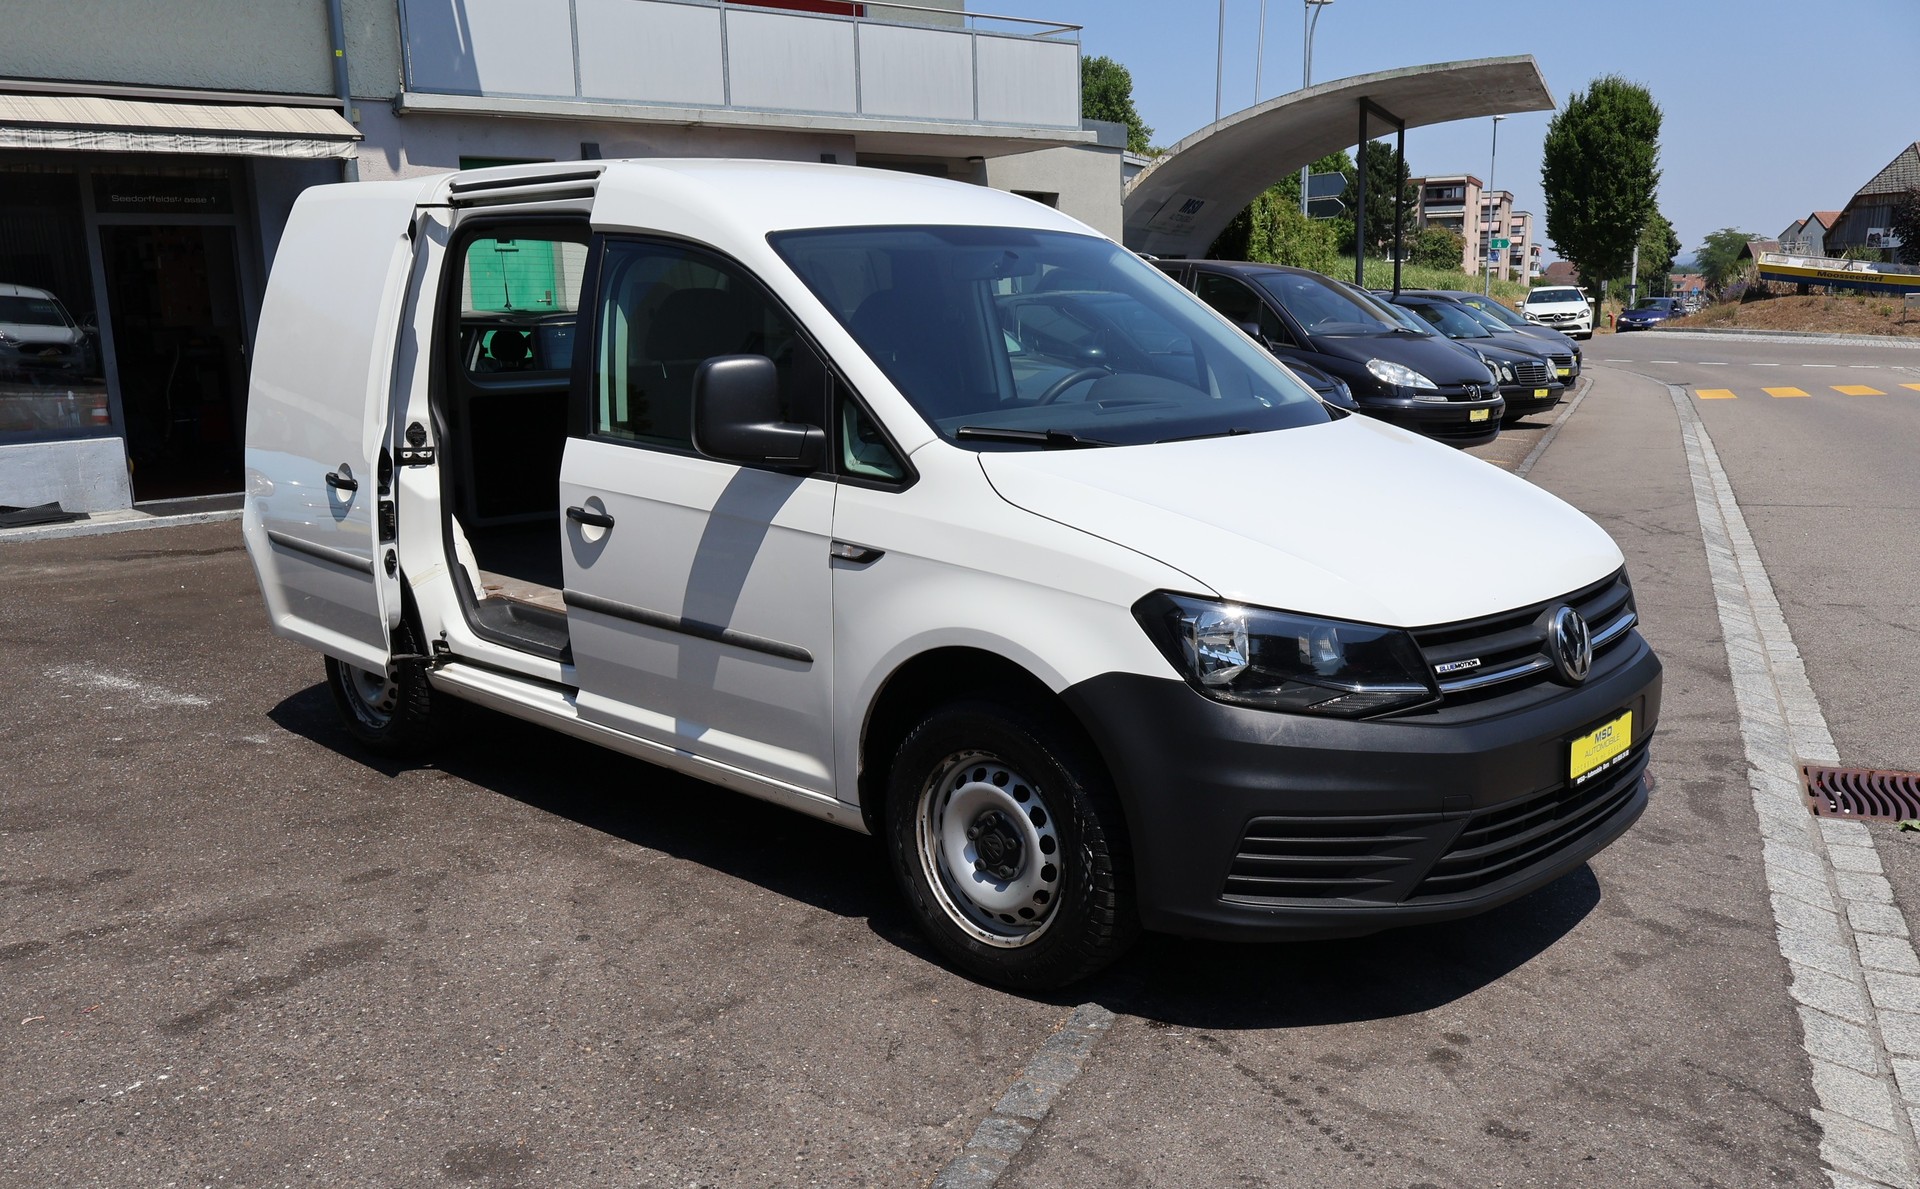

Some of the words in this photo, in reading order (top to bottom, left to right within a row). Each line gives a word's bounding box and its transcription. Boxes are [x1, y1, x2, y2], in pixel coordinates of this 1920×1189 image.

[1816, 271, 1884, 283] Moosseedorf
[1439, 660, 1478, 672] BLUEMOTION
[1594, 725, 1613, 744] MSD
[1585, 733, 1621, 758] AUTOMOBILE
